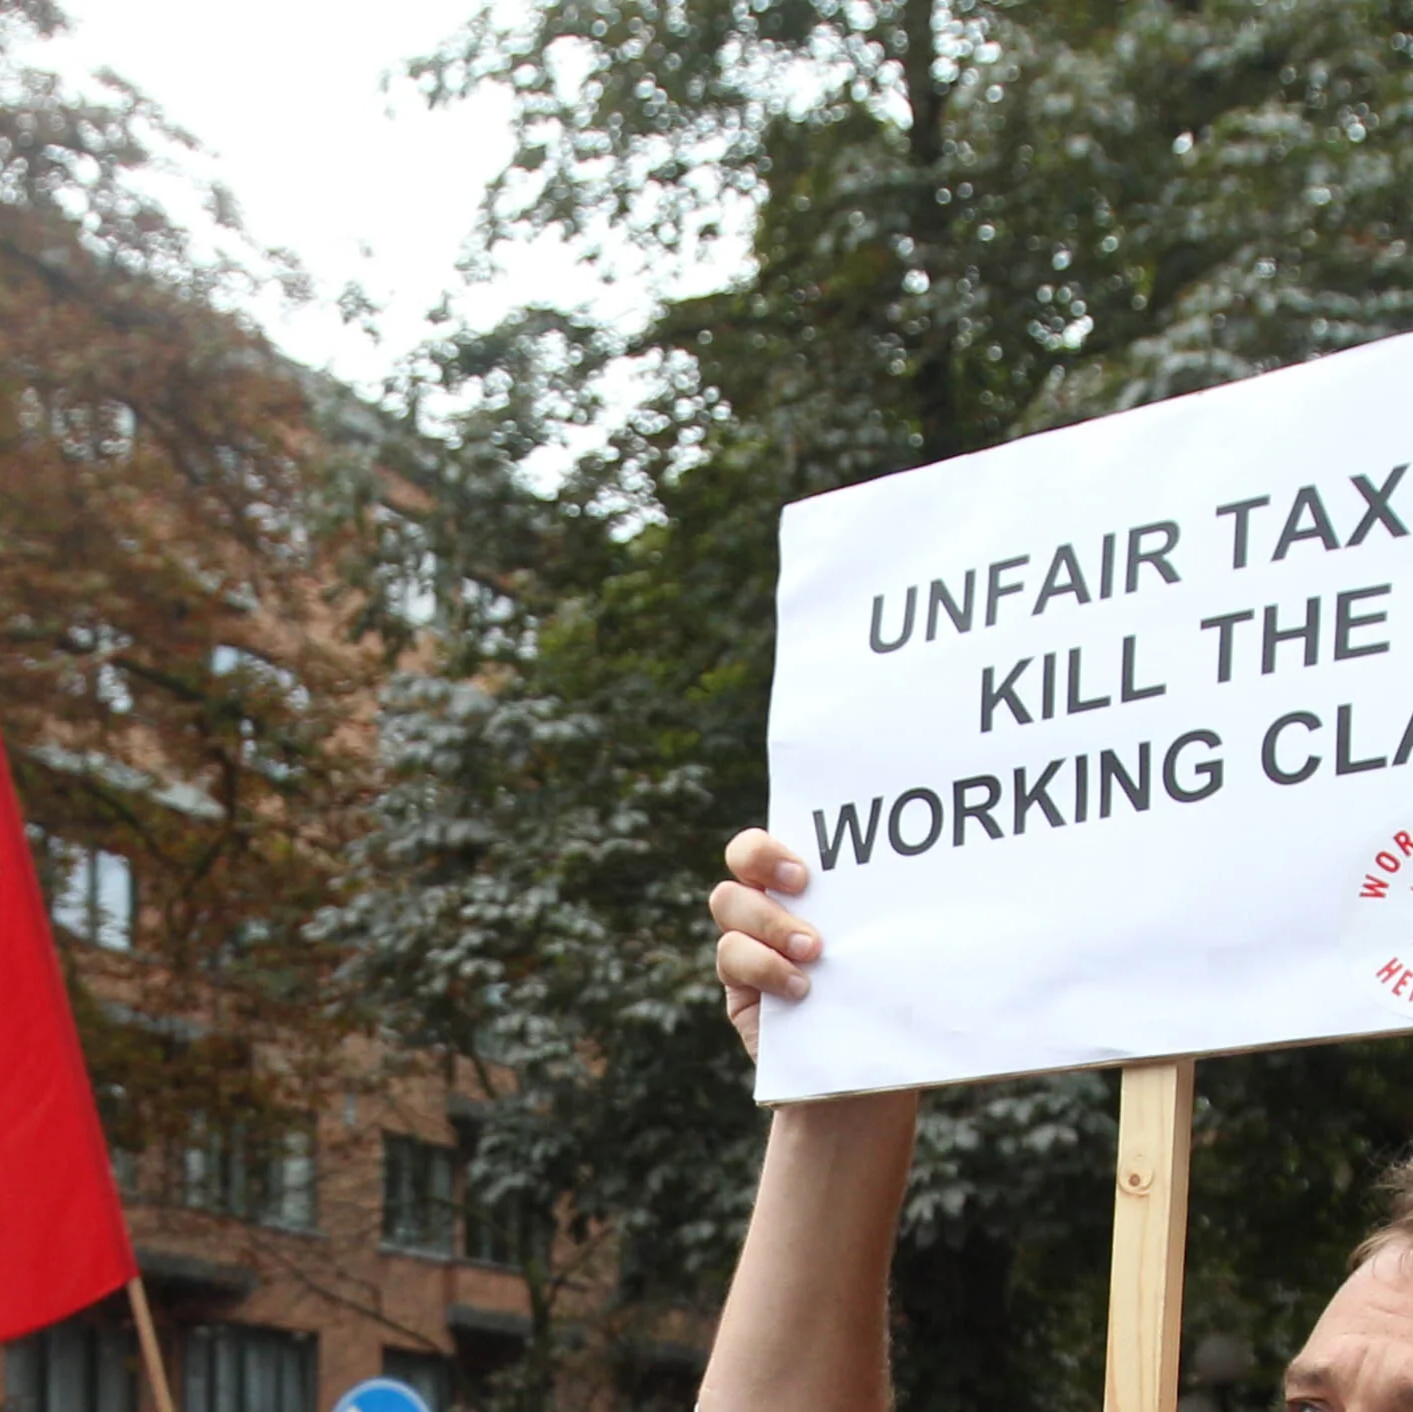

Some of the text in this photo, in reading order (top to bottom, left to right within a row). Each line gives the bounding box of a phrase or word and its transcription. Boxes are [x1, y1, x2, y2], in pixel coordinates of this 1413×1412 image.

[869, 521, 1180, 654] UNFAIR
[980, 584, 1391, 733] KILL THE
[812, 729, 1223, 871] WORKING
